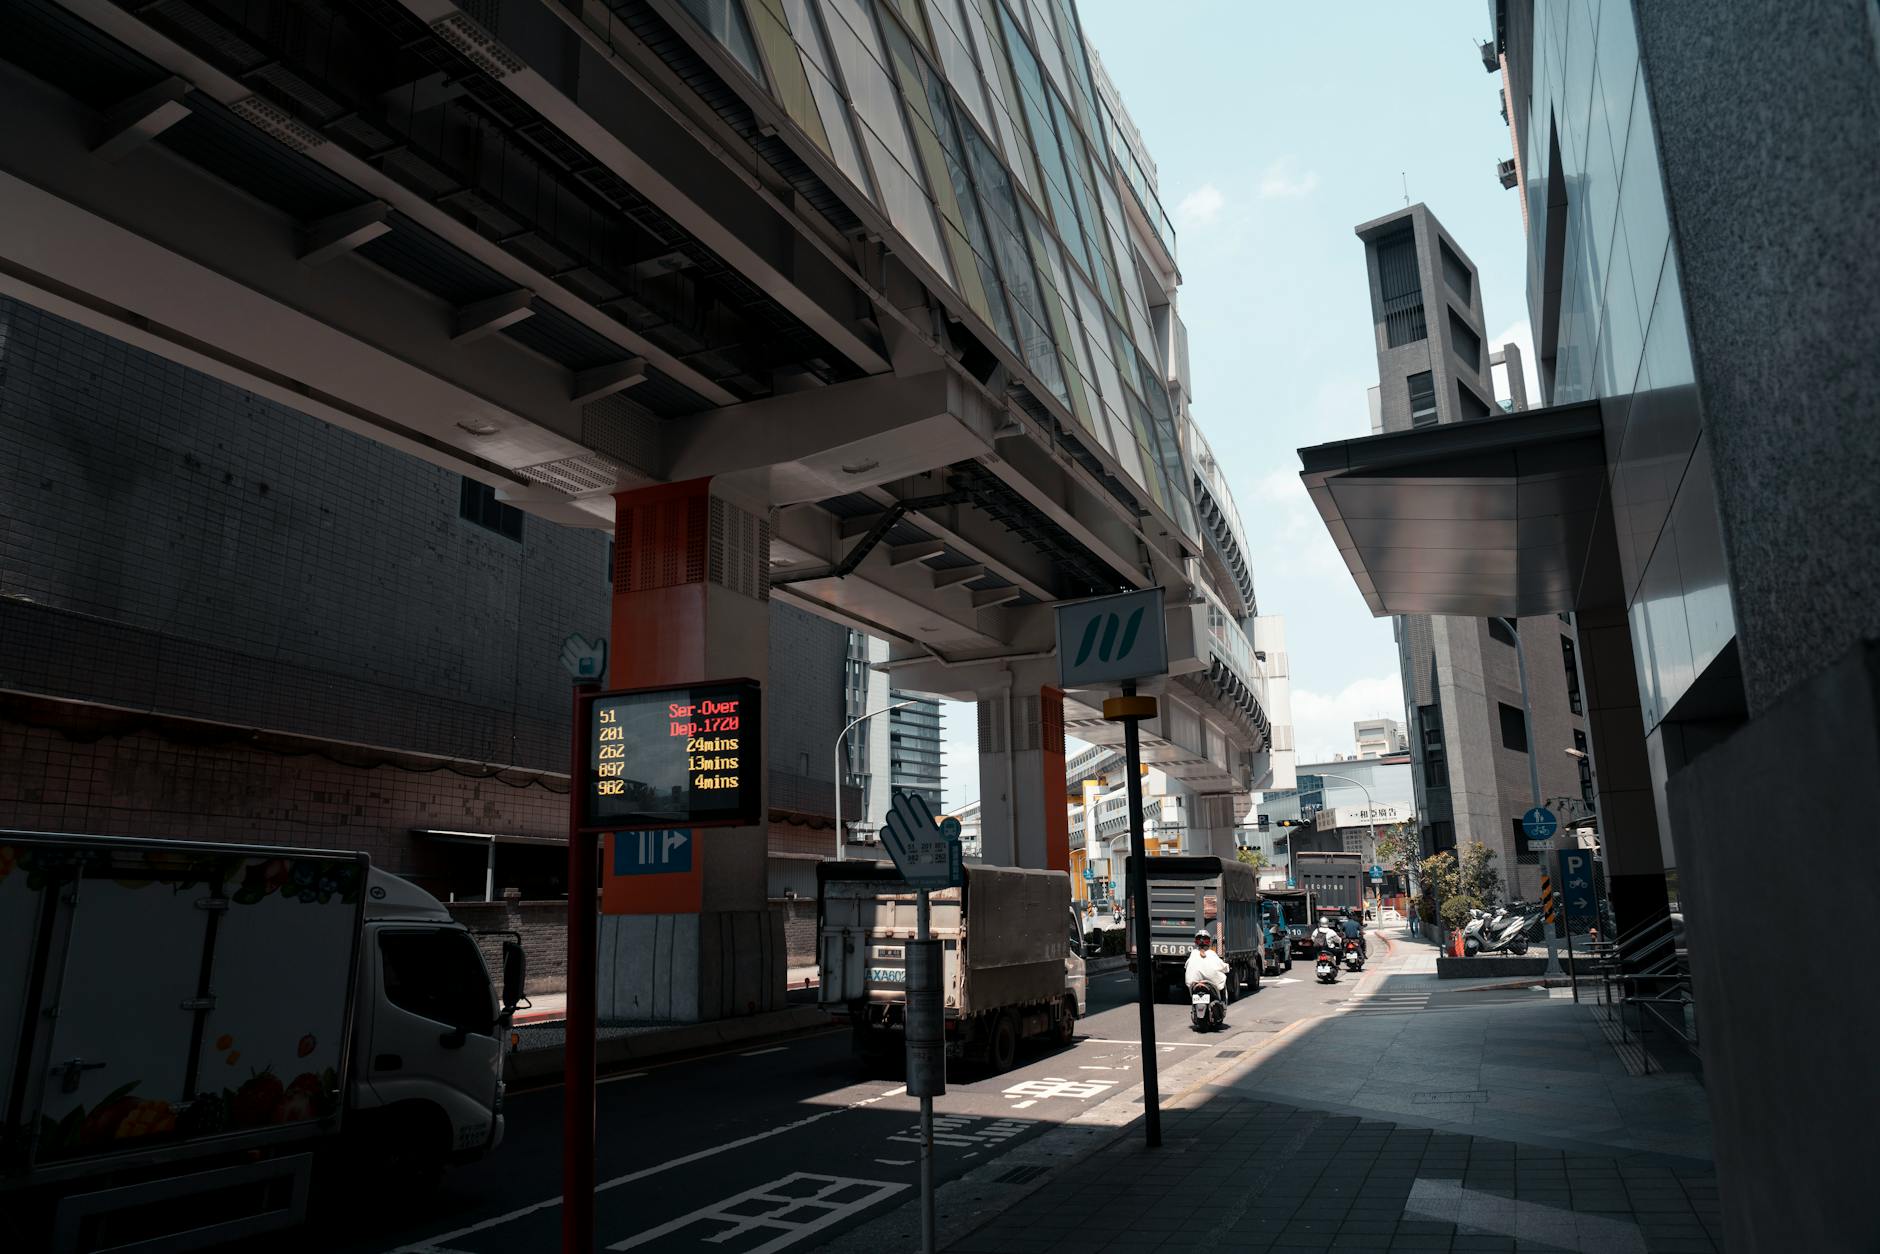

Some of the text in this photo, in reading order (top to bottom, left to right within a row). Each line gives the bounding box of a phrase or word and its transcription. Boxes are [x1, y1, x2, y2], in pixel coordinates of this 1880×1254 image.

[600, 710, 616, 723] 51
[600, 727, 624, 741] 201
[599, 744, 625, 759] 262
[599, 762, 625, 777] 897
[598, 780, 625, 795] 982
[1567, 856, 1583, 874] P
